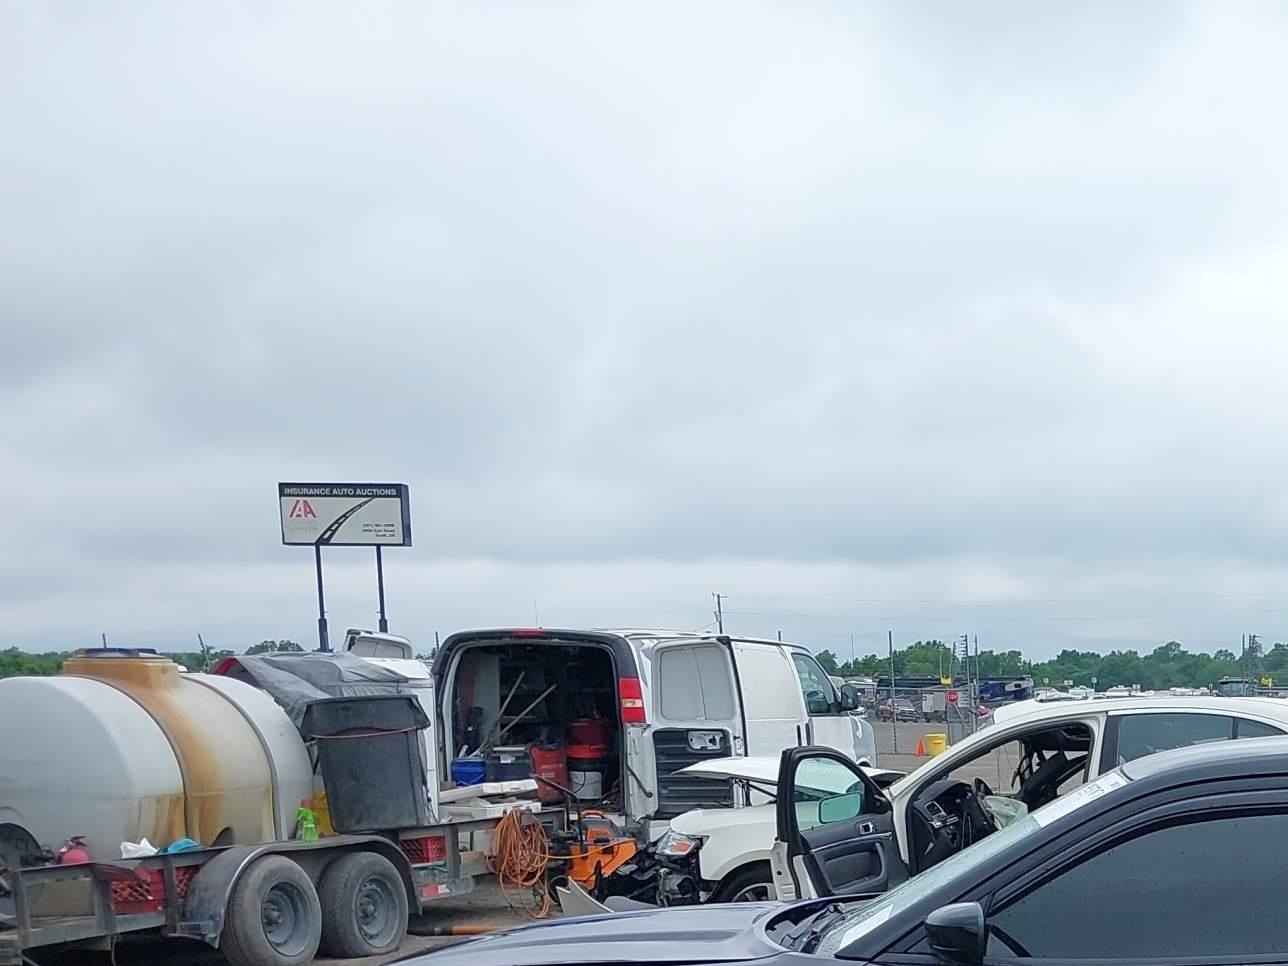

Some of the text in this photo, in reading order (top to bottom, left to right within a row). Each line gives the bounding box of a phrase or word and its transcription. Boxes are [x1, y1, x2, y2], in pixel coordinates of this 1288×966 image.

[284, 487, 397, 496] INSURANCE AUTO AUCTIONS
